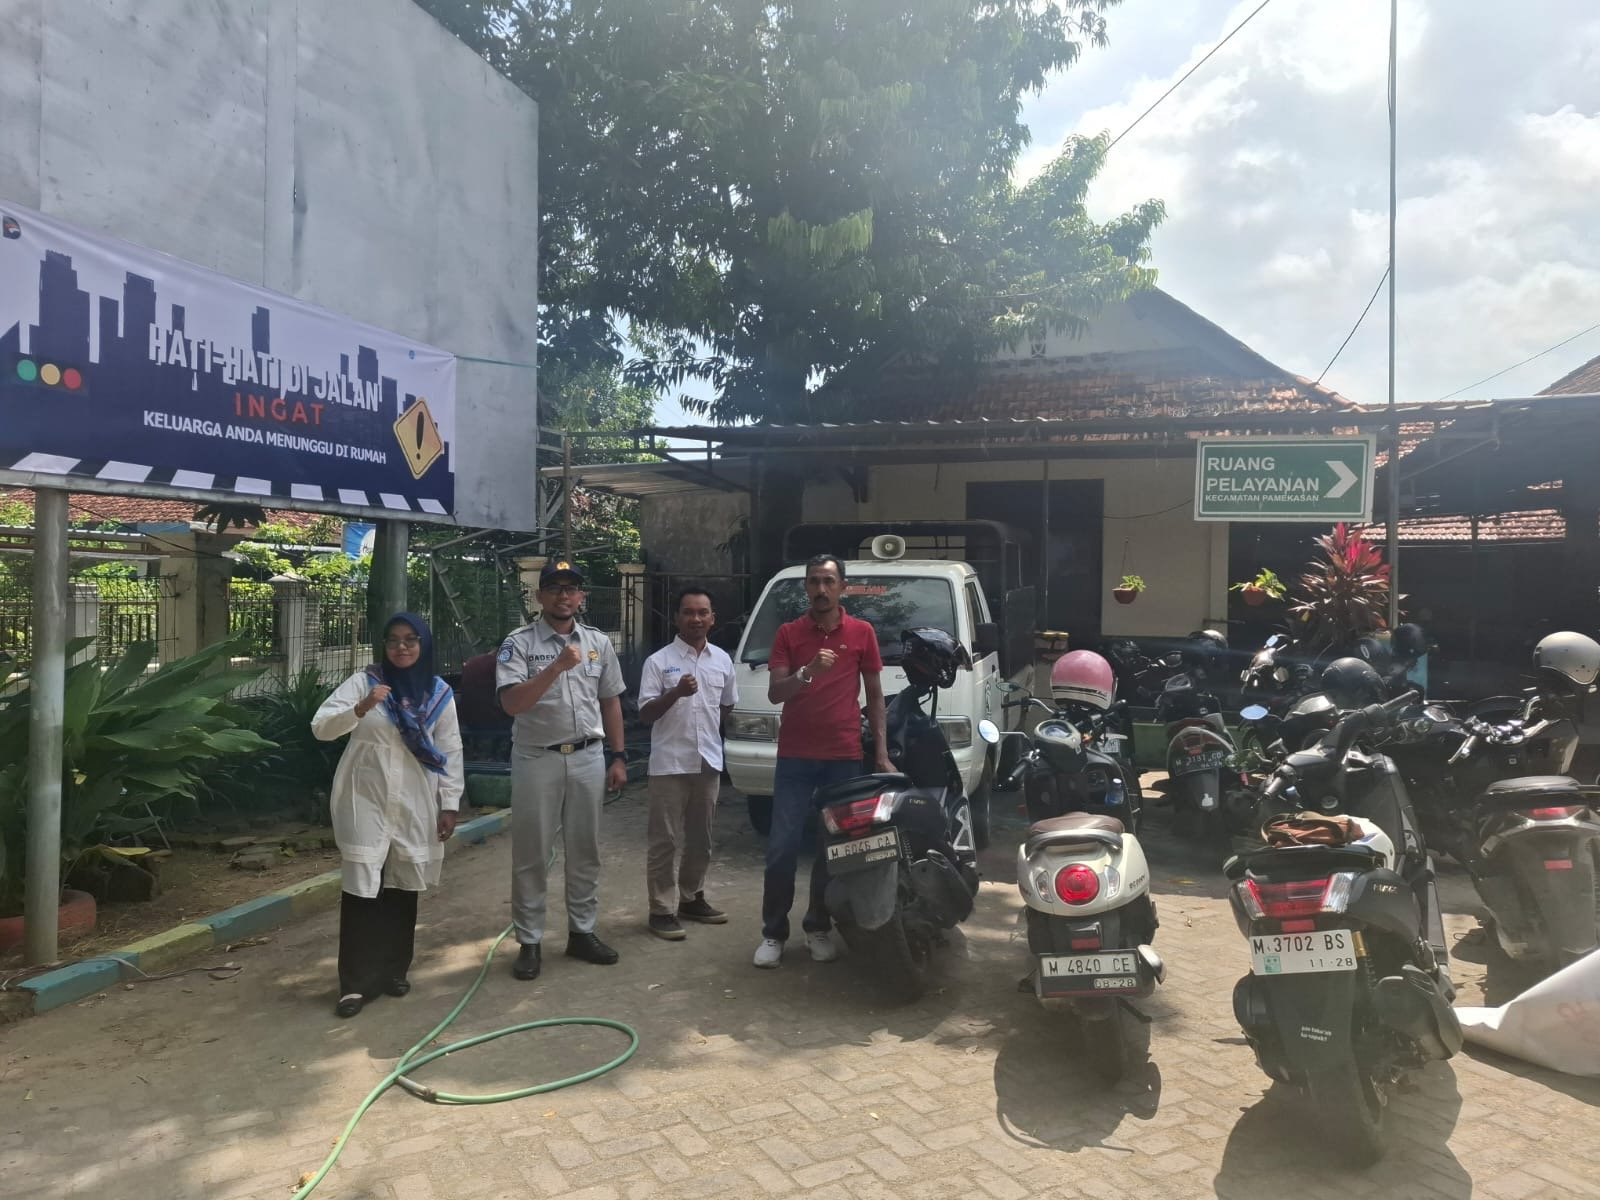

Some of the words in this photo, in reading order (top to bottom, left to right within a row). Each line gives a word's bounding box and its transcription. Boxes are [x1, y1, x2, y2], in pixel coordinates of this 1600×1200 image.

[314, 370, 382, 412] JALAN
[234, 391, 324, 425] INGAT
[143, 410, 222, 438] KELUARGA
[226, 425, 264, 444] ANDA
[266, 431, 333, 455] MENUNGGU
[335, 444, 348, 458] DI
[350, 446, 386, 464] RUMAH
[1207, 457, 1275, 471] RUANG
[1206, 477, 1319, 492] PELAYANAN
[1262, 494, 1319, 502] PAMEKASAN
[831, 847, 839, 860] M
[1253, 938, 1265, 955] M
[1274, 935, 1314, 953] 3702
[1324, 933, 1345, 950] BS
[1050, 961, 1058, 974] M
[1067, 959, 1101, 974] 4840
[1113, 958, 1131, 972] CE
